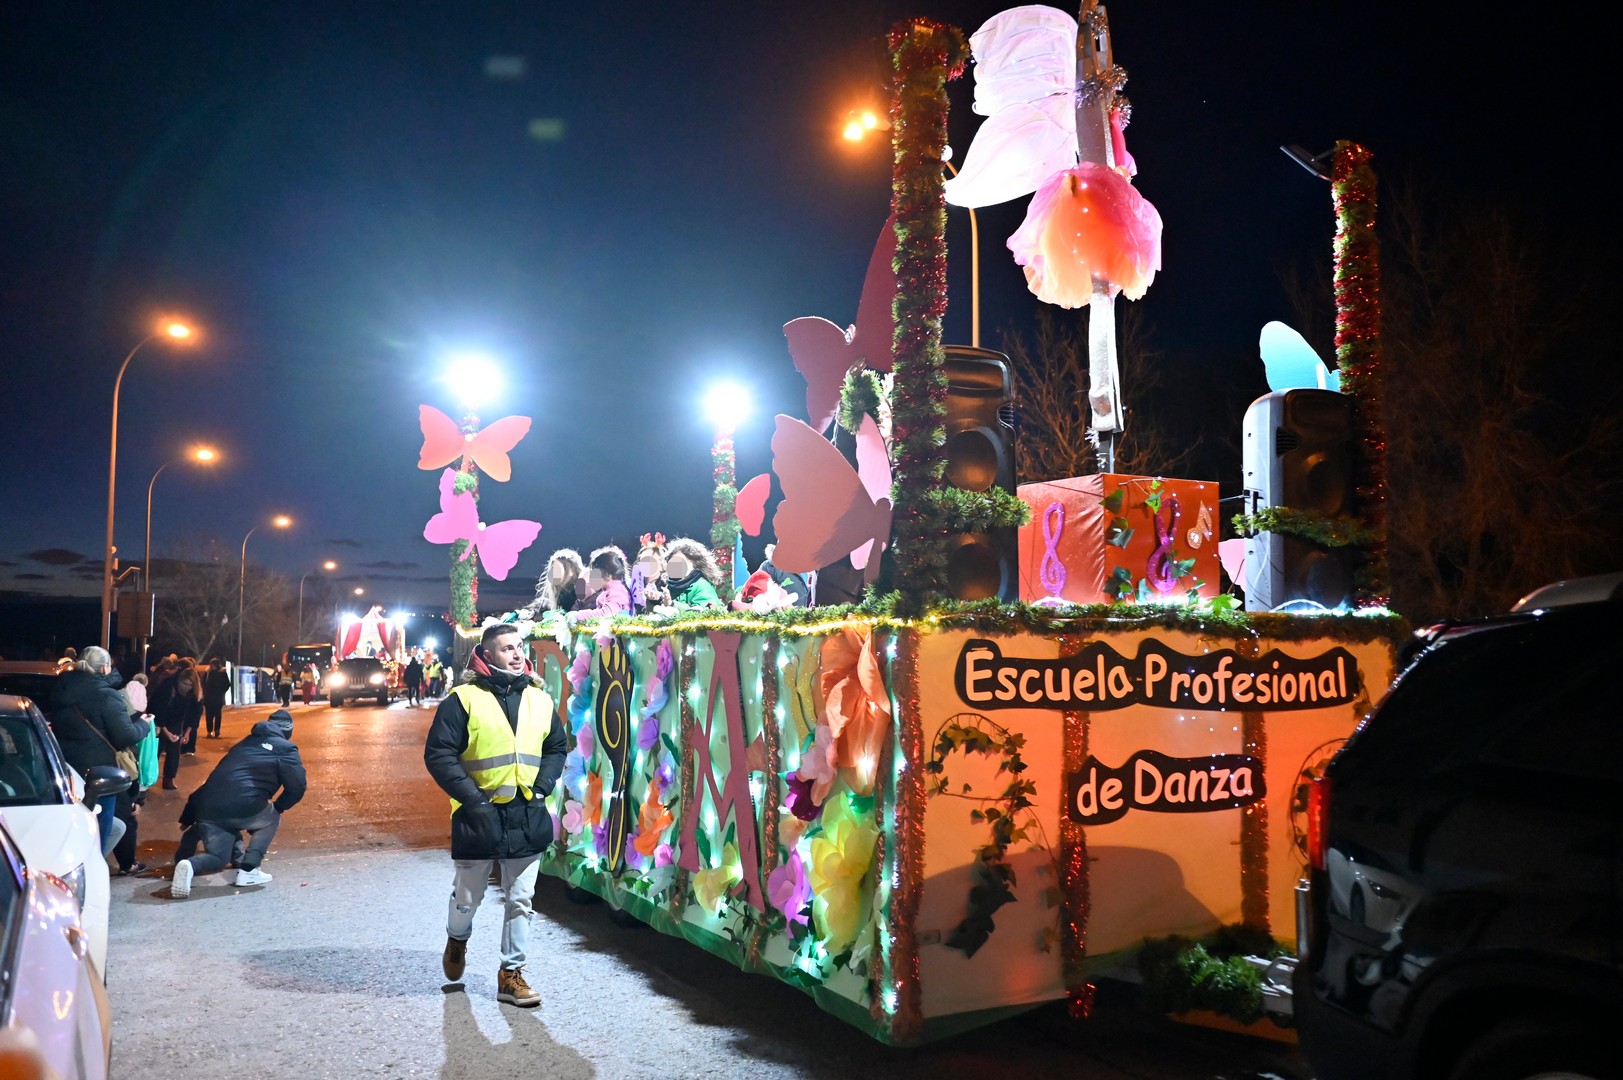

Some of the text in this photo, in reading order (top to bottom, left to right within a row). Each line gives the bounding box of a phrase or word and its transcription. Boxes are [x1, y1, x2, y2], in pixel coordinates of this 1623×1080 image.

[965, 649, 1348, 704] Escuela Profesional
[1075, 758, 1254, 817] de Danza
